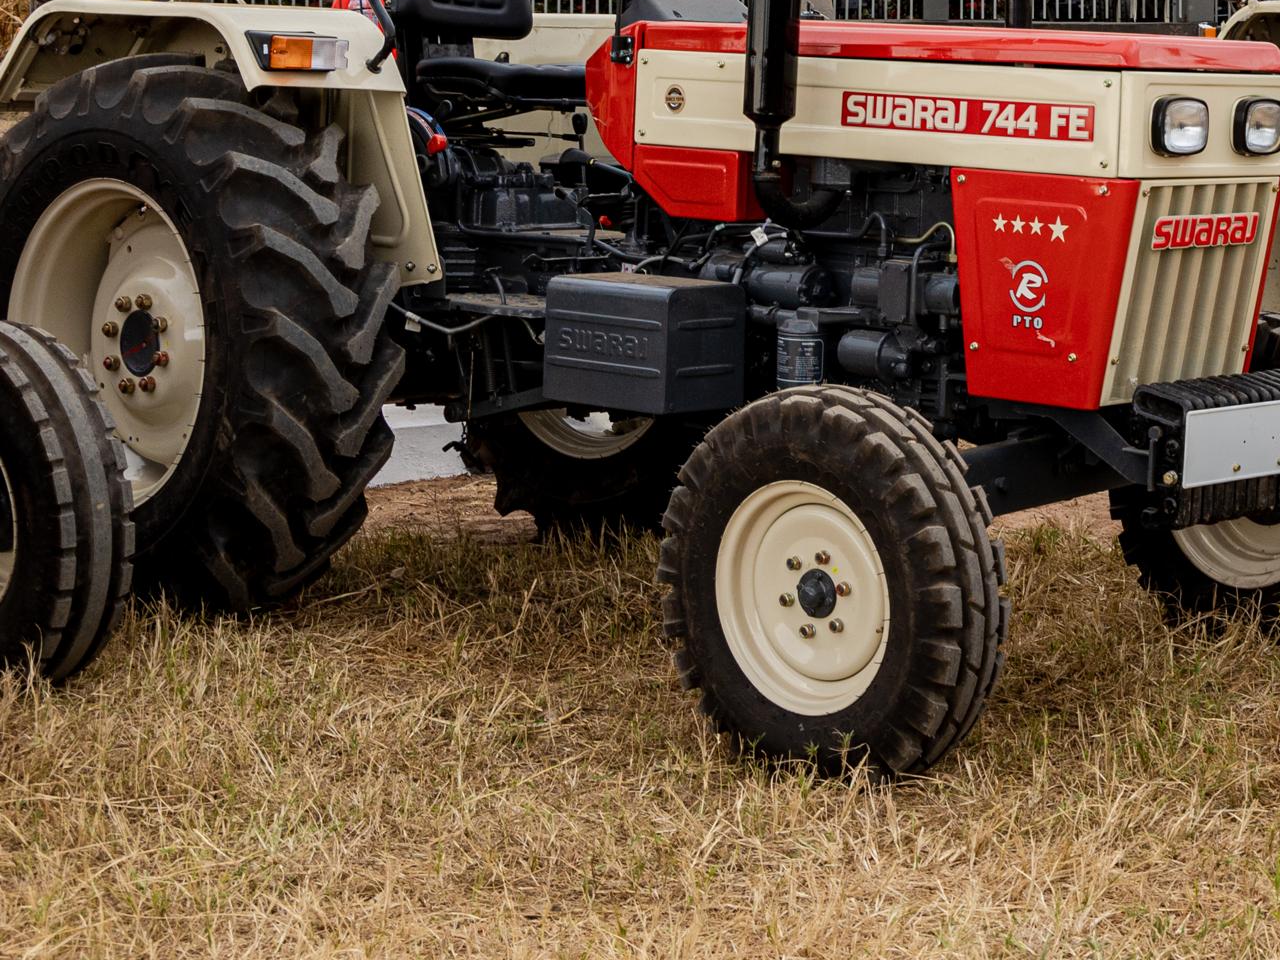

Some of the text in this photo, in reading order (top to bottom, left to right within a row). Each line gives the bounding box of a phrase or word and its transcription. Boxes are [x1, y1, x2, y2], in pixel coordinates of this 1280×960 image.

[980, 102, 1039, 137] 744
[1049, 105, 1091, 140] FE
[1012, 314, 1043, 329] PTO
